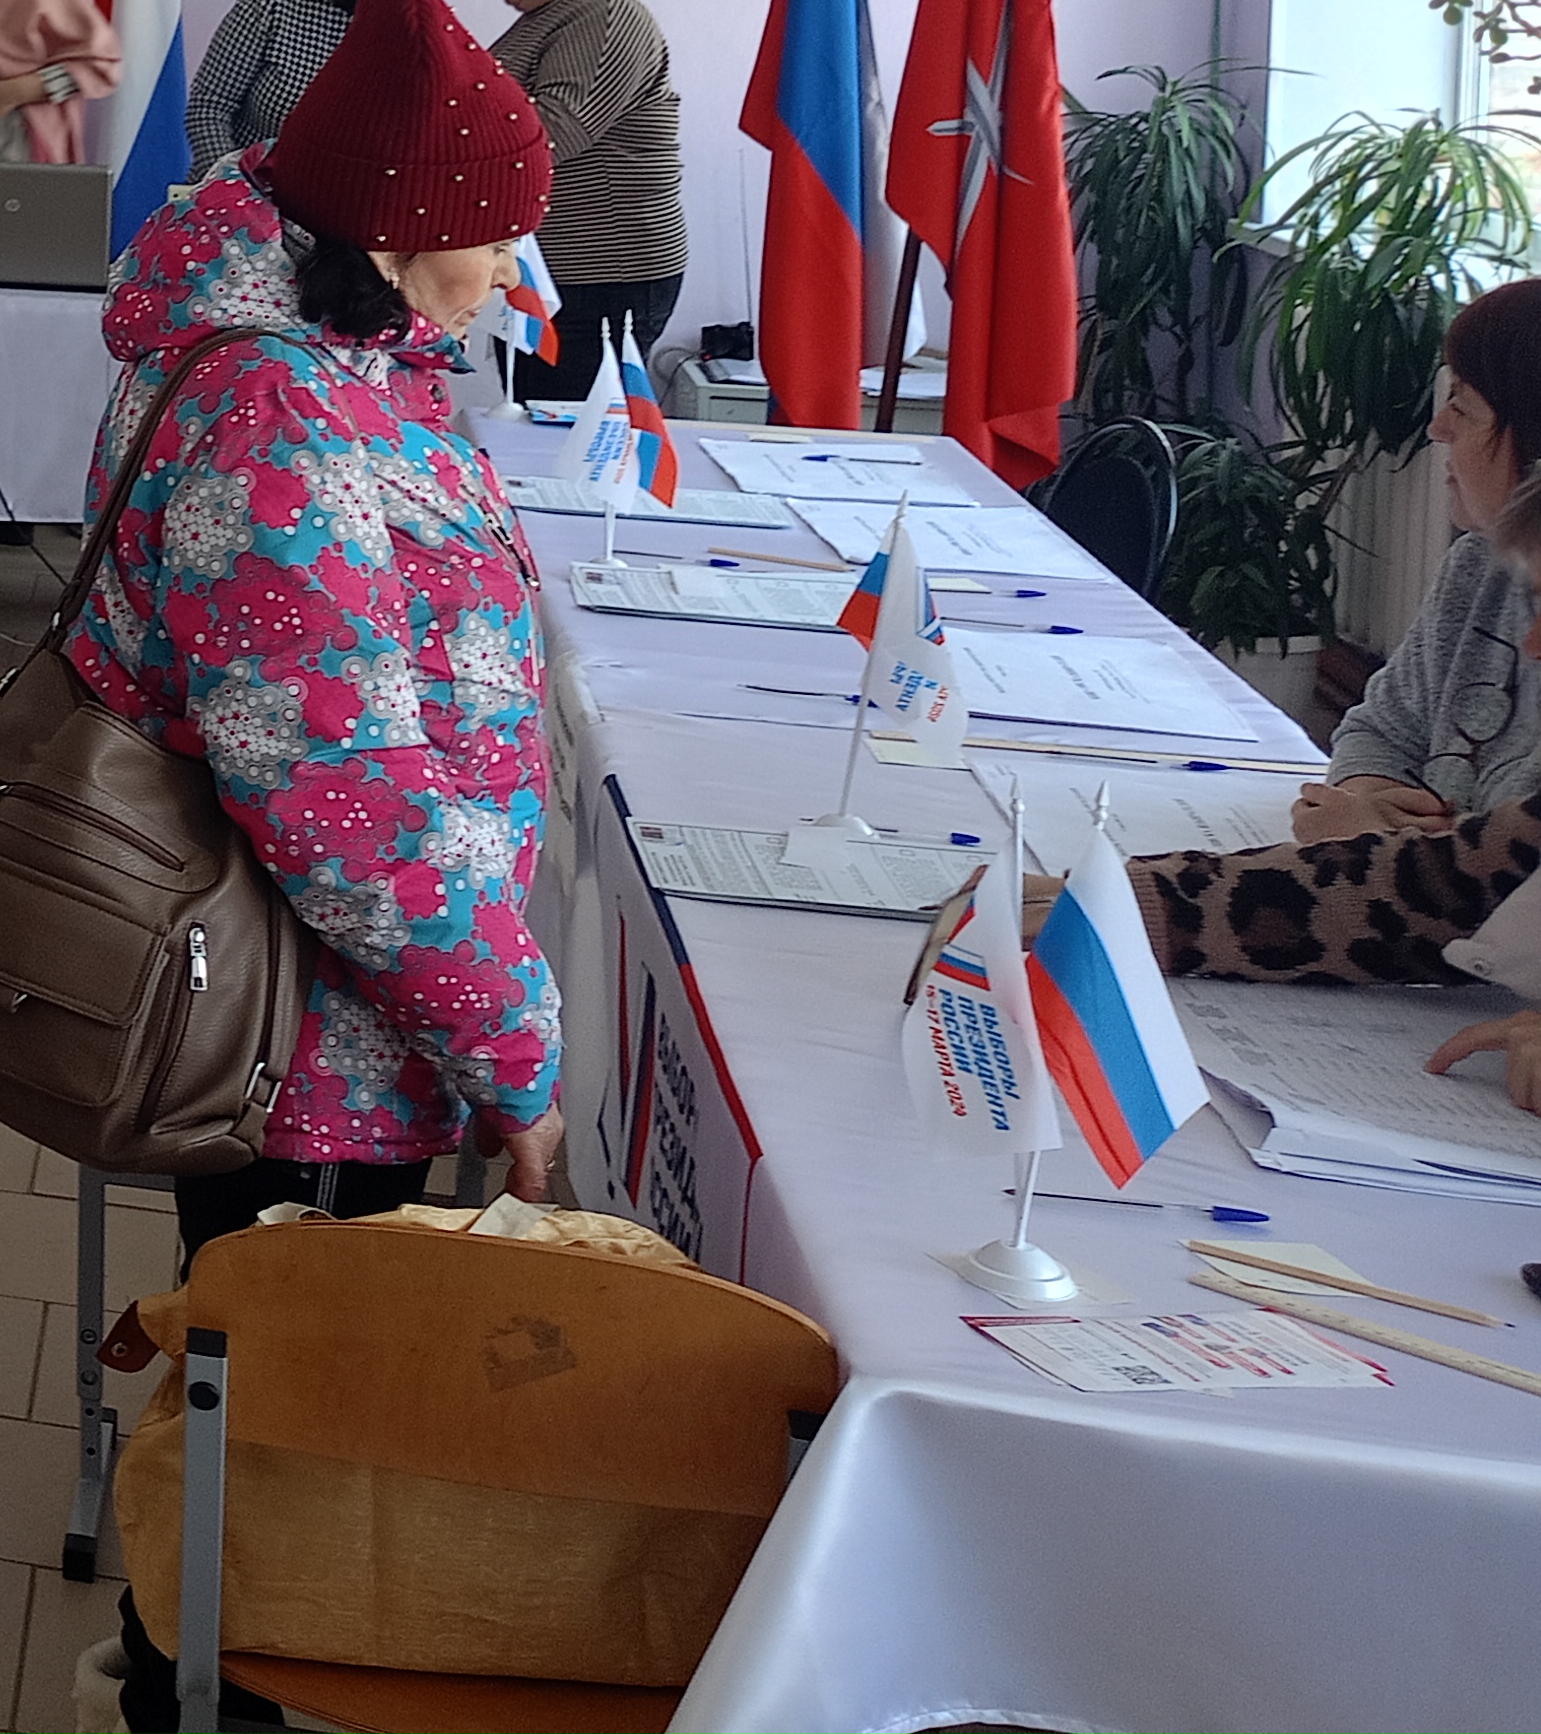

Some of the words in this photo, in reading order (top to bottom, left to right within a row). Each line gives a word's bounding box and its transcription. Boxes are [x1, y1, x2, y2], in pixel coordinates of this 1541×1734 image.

[929, 1025, 955, 1078] МАРТА
[938, 988, 973, 1075] РОССИИ
[957, 995, 1011, 1131] ПРЕЗИДЕНТА
[978, 1002, 1021, 1100] ВЫБОРЫ
